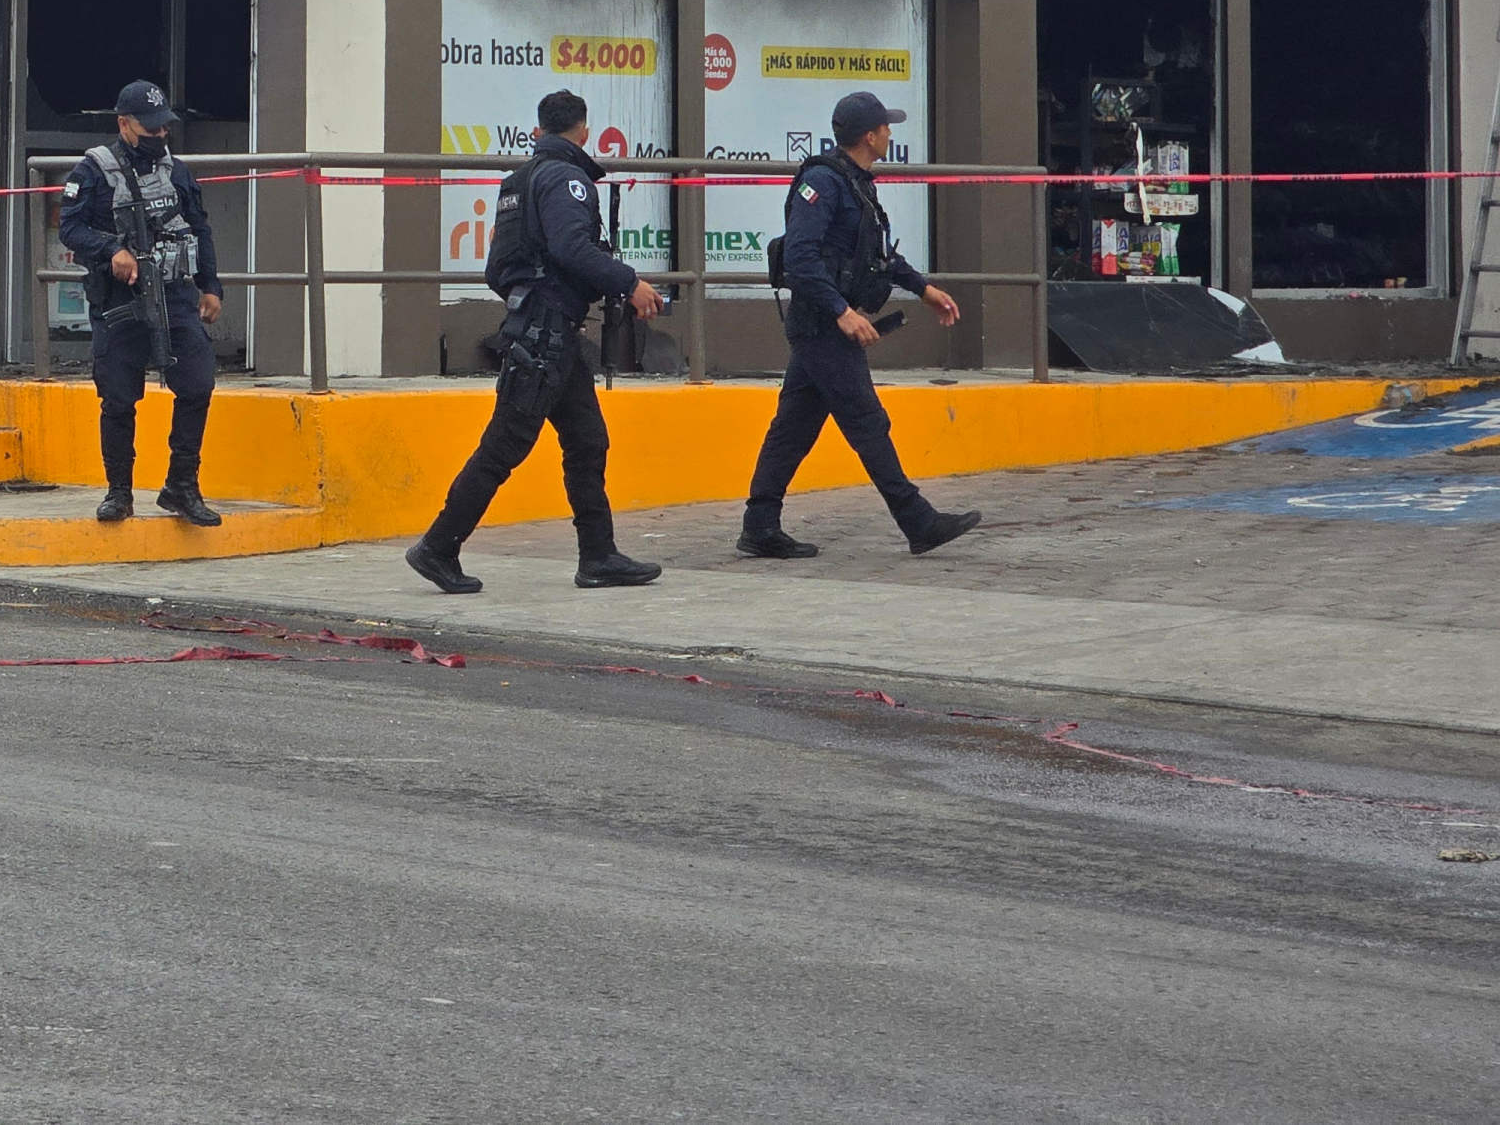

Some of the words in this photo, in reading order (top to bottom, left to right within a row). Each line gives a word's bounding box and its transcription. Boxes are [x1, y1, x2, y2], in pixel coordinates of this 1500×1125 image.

[442, 38, 482, 65] obra
[491, 38, 544, 66] hasta
[557, 39, 646, 71] $4,000
[705, 57, 732, 69] 2,000
[766, 52, 792, 72] ¡MÁS
[796, 53, 835, 70] RÁPIDO
[838, 57, 846, 70] Y
[849, 54, 871, 71] MÁS
[875, 55, 905, 73] FÁCIL!
[451, 199, 494, 259] ri
[621, 251, 669, 260] TERNATIO
[705, 253, 726, 261] ONEY
[728, 253, 763, 262] EXPRESS
